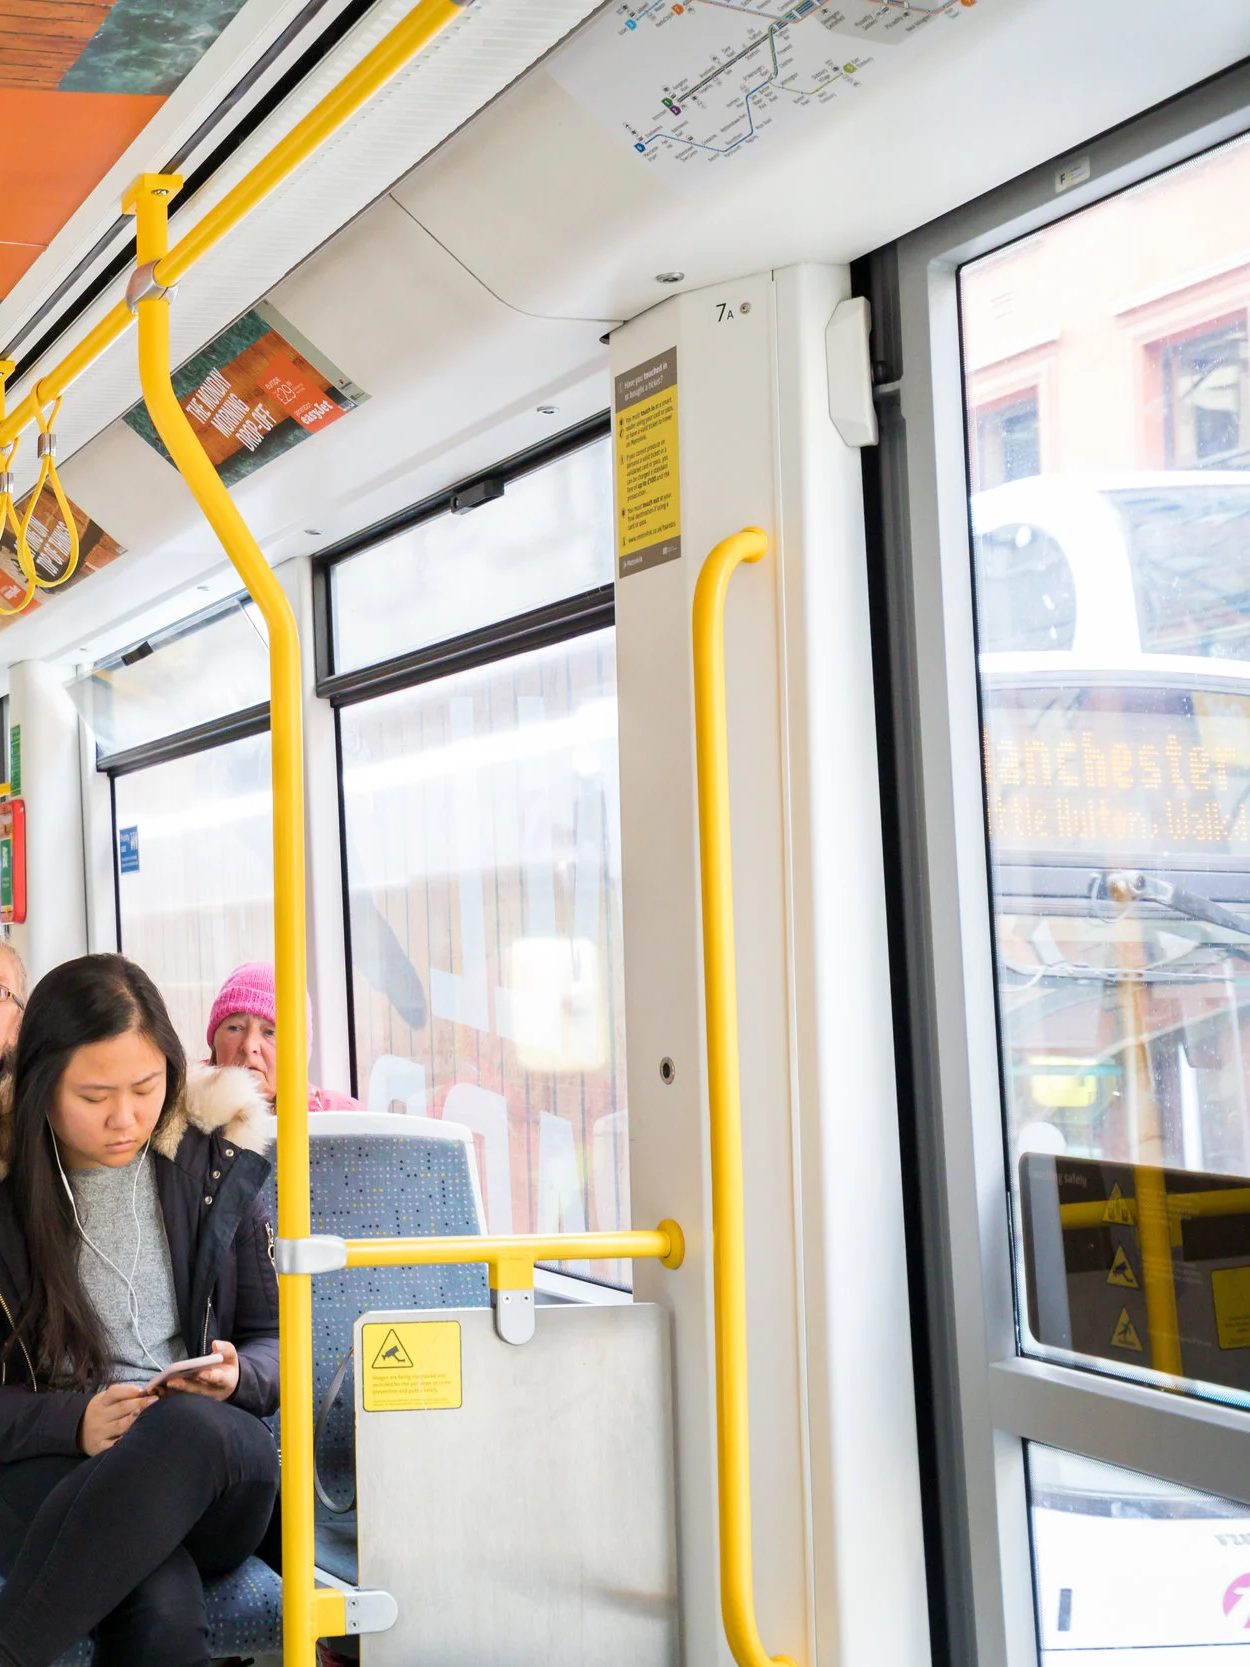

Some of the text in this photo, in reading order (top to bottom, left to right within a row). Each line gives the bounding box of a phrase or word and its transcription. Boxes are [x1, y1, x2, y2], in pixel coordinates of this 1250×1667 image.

[715, 302, 735, 322] 7A
[643, 363, 661, 380] touched
[185, 367, 232, 425] THE MONDAY
[210, 392, 250, 439] MORNING
[300, 399, 333, 425] easyJet
[235, 402, 277, 452] DROP-OFF
[983, 728, 1237, 791] anchester
[985, 796, 1049, 837] ittle
